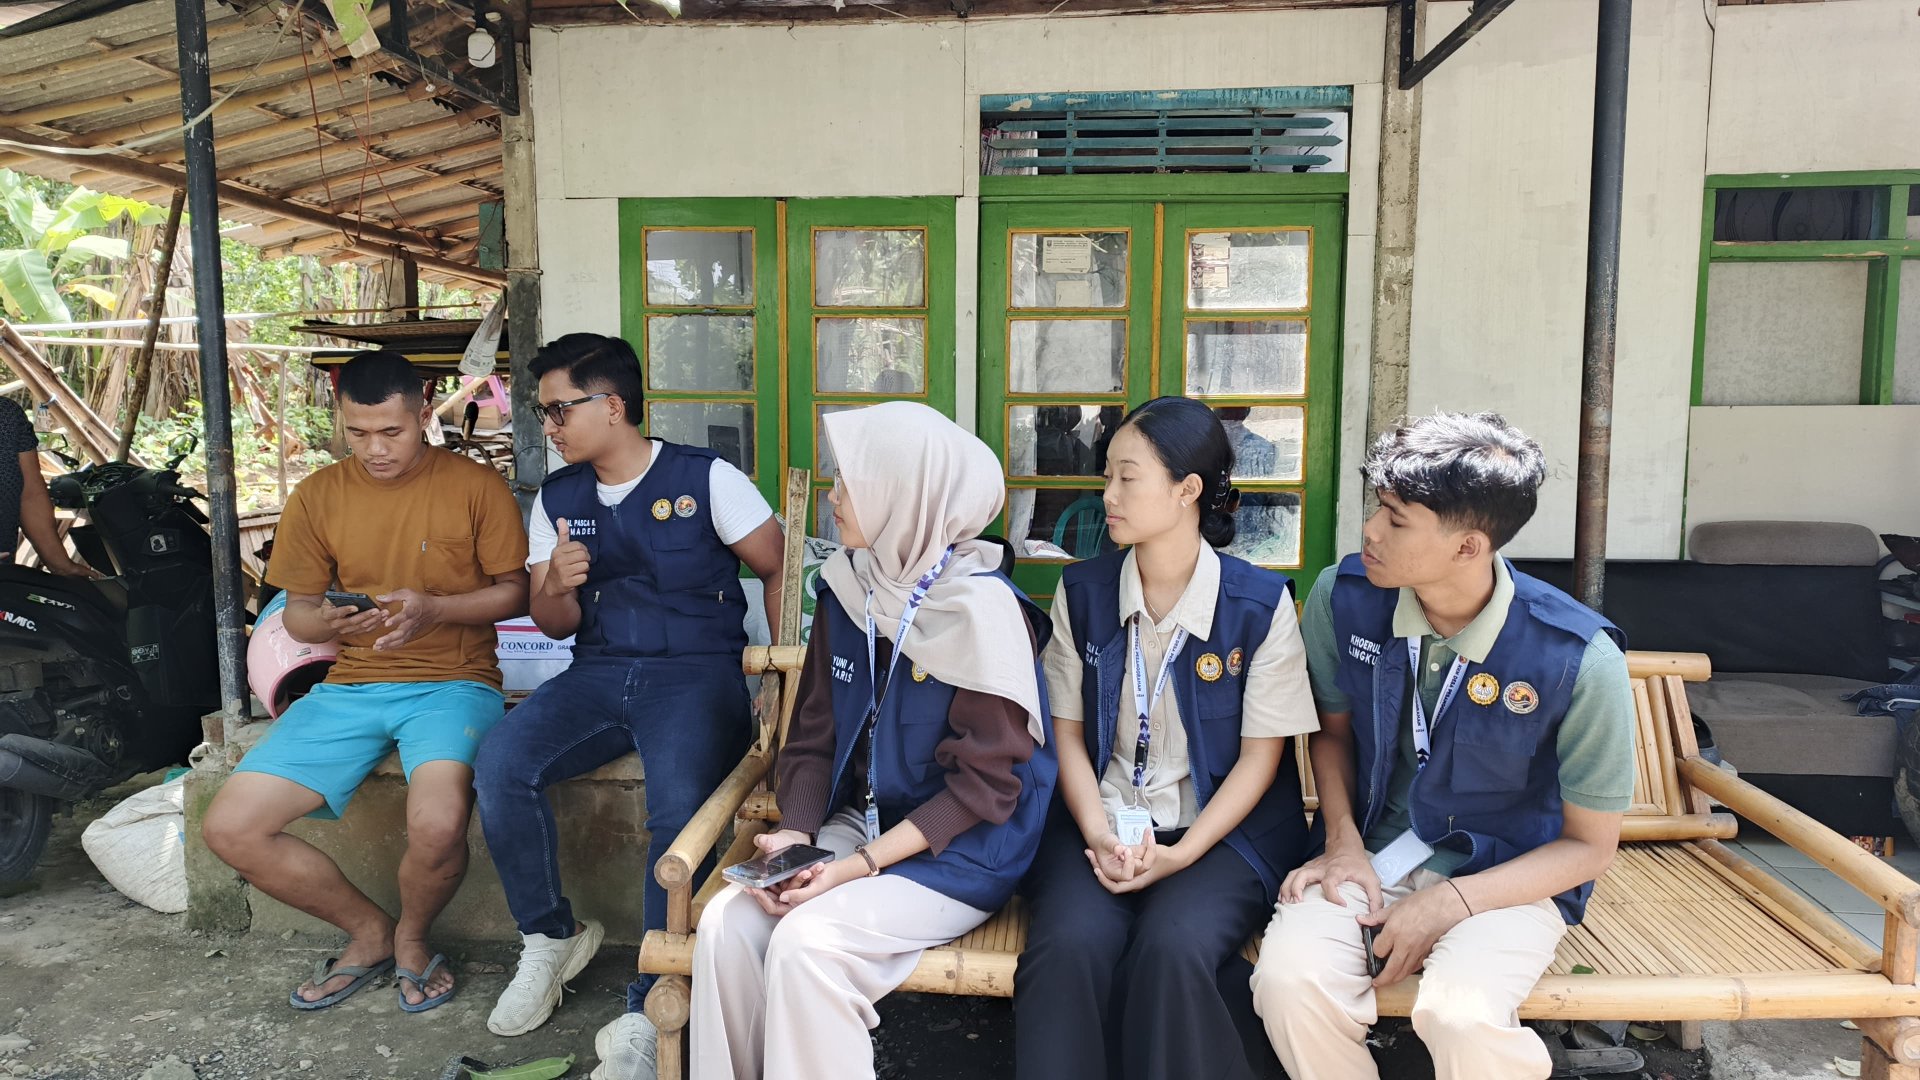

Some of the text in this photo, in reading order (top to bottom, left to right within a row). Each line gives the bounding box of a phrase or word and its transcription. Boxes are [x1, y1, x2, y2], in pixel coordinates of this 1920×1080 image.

[570, 527, 596, 536] MADES
[501, 641, 554, 651] CONCORD
[1350, 634, 1381, 655] KHOERUL
[833, 655, 848, 669] YUNI
[1348, 645, 1378, 666] LINGKU
[831, 665, 853, 683] TARIS
[1449, 675, 1459, 688] DESA
